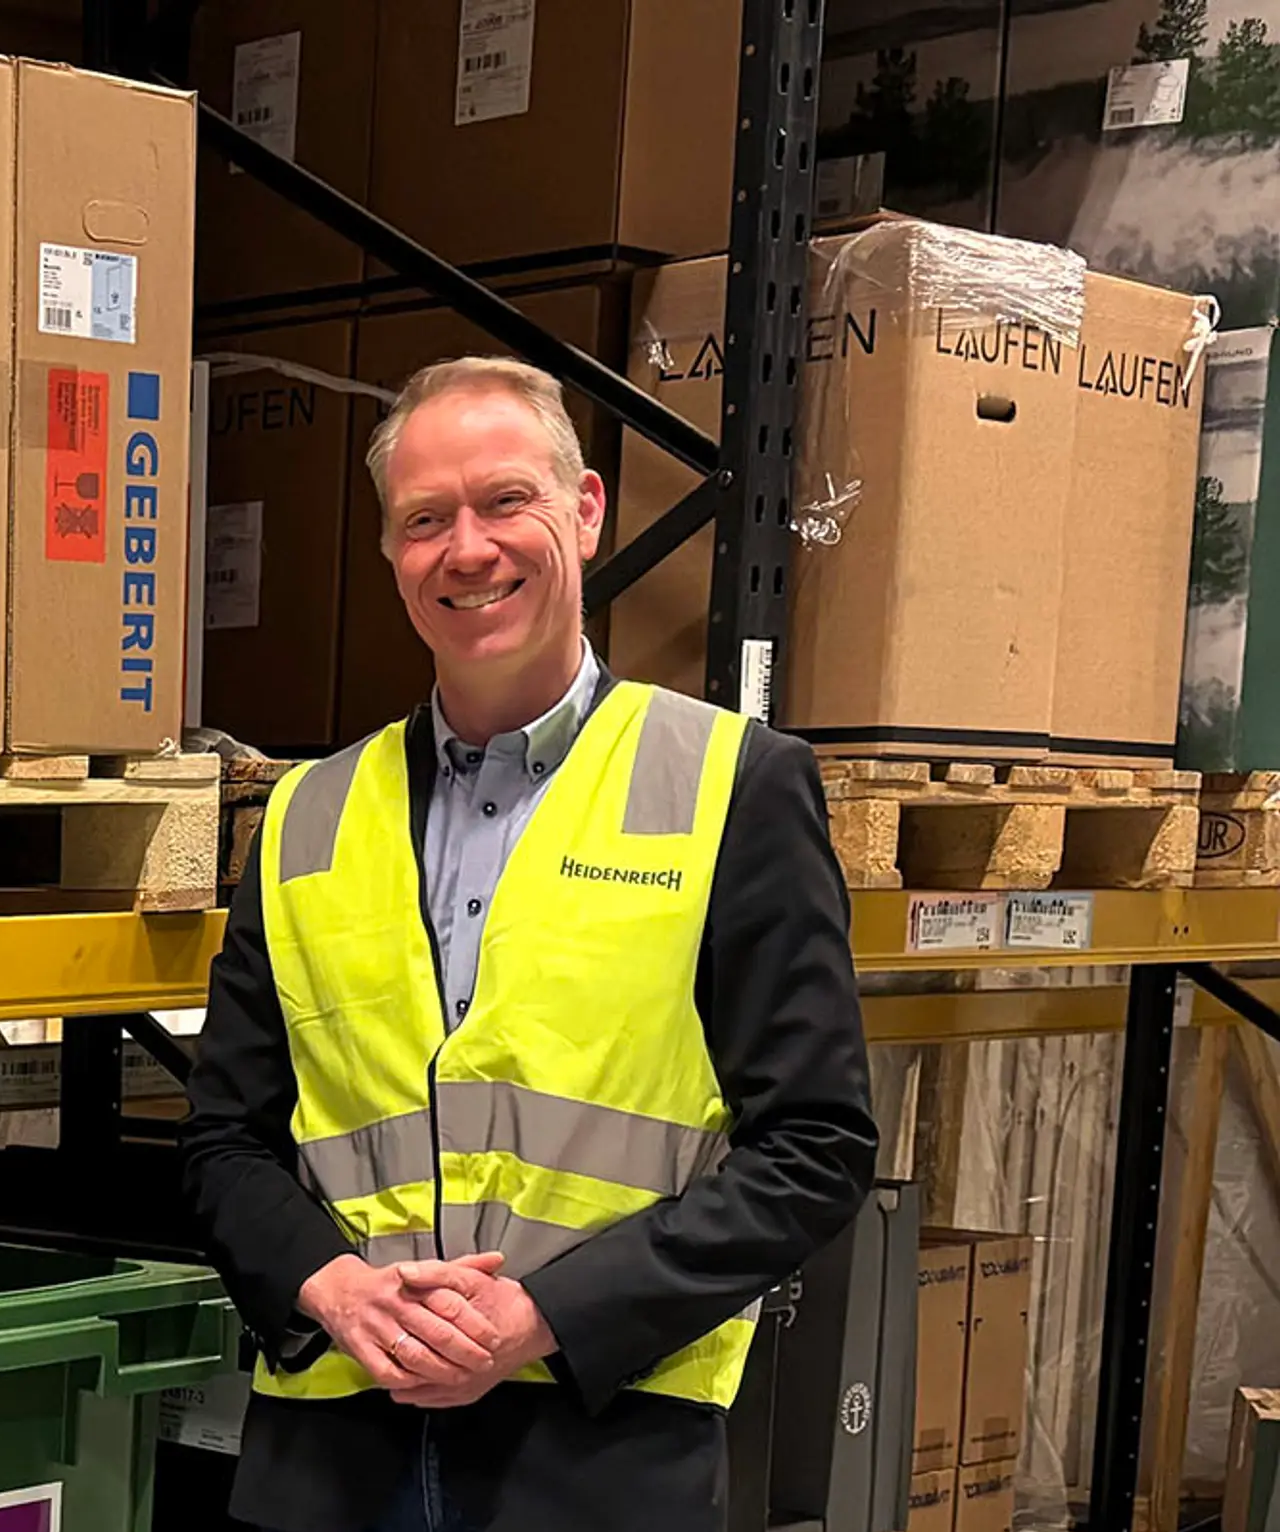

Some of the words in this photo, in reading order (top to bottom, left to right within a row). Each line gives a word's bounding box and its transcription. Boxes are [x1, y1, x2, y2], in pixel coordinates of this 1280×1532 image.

[936, 308, 1061, 374] LAUFEN
[1078, 346, 1192, 409] LAUFEN
[119, 432, 160, 712] GEBERIT
[561, 856, 682, 892] HEIDENREICH
